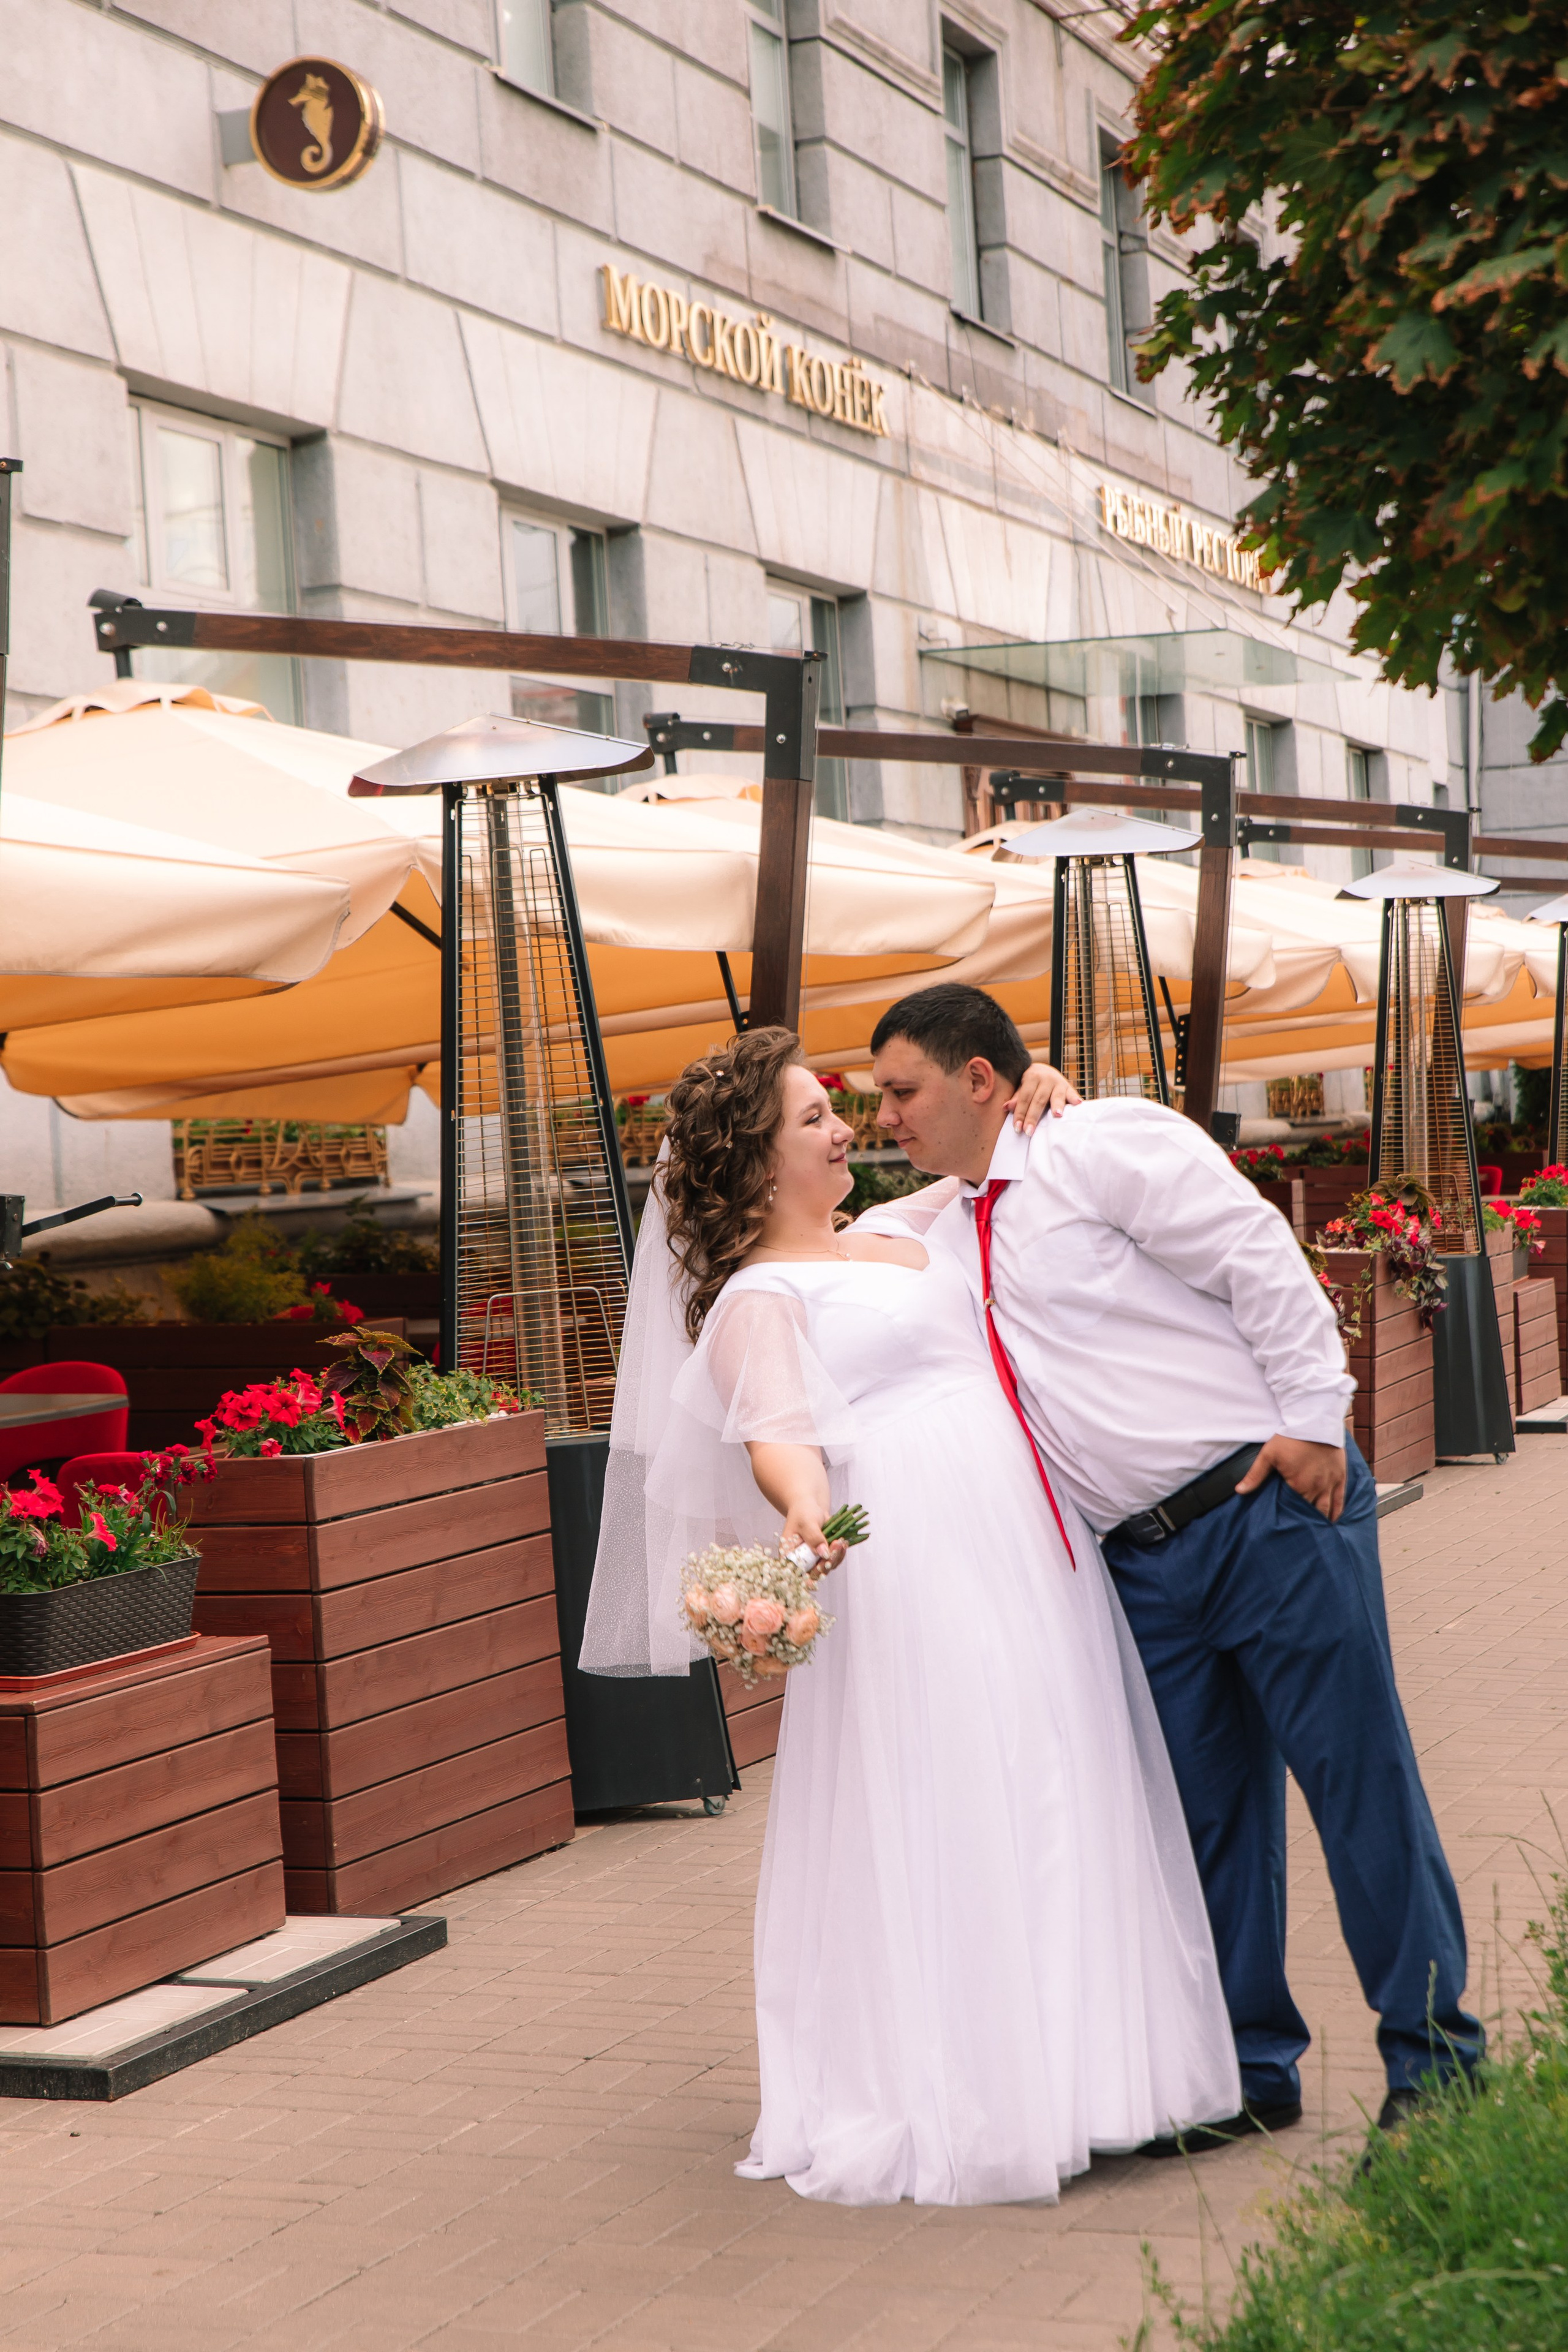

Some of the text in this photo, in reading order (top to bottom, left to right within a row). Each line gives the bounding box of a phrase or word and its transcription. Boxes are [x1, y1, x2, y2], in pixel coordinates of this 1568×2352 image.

[601, 263, 891, 438] МОРСКОЙ КОНЁК
[1100, 483, 1190, 560] РЫБНЫЙ
